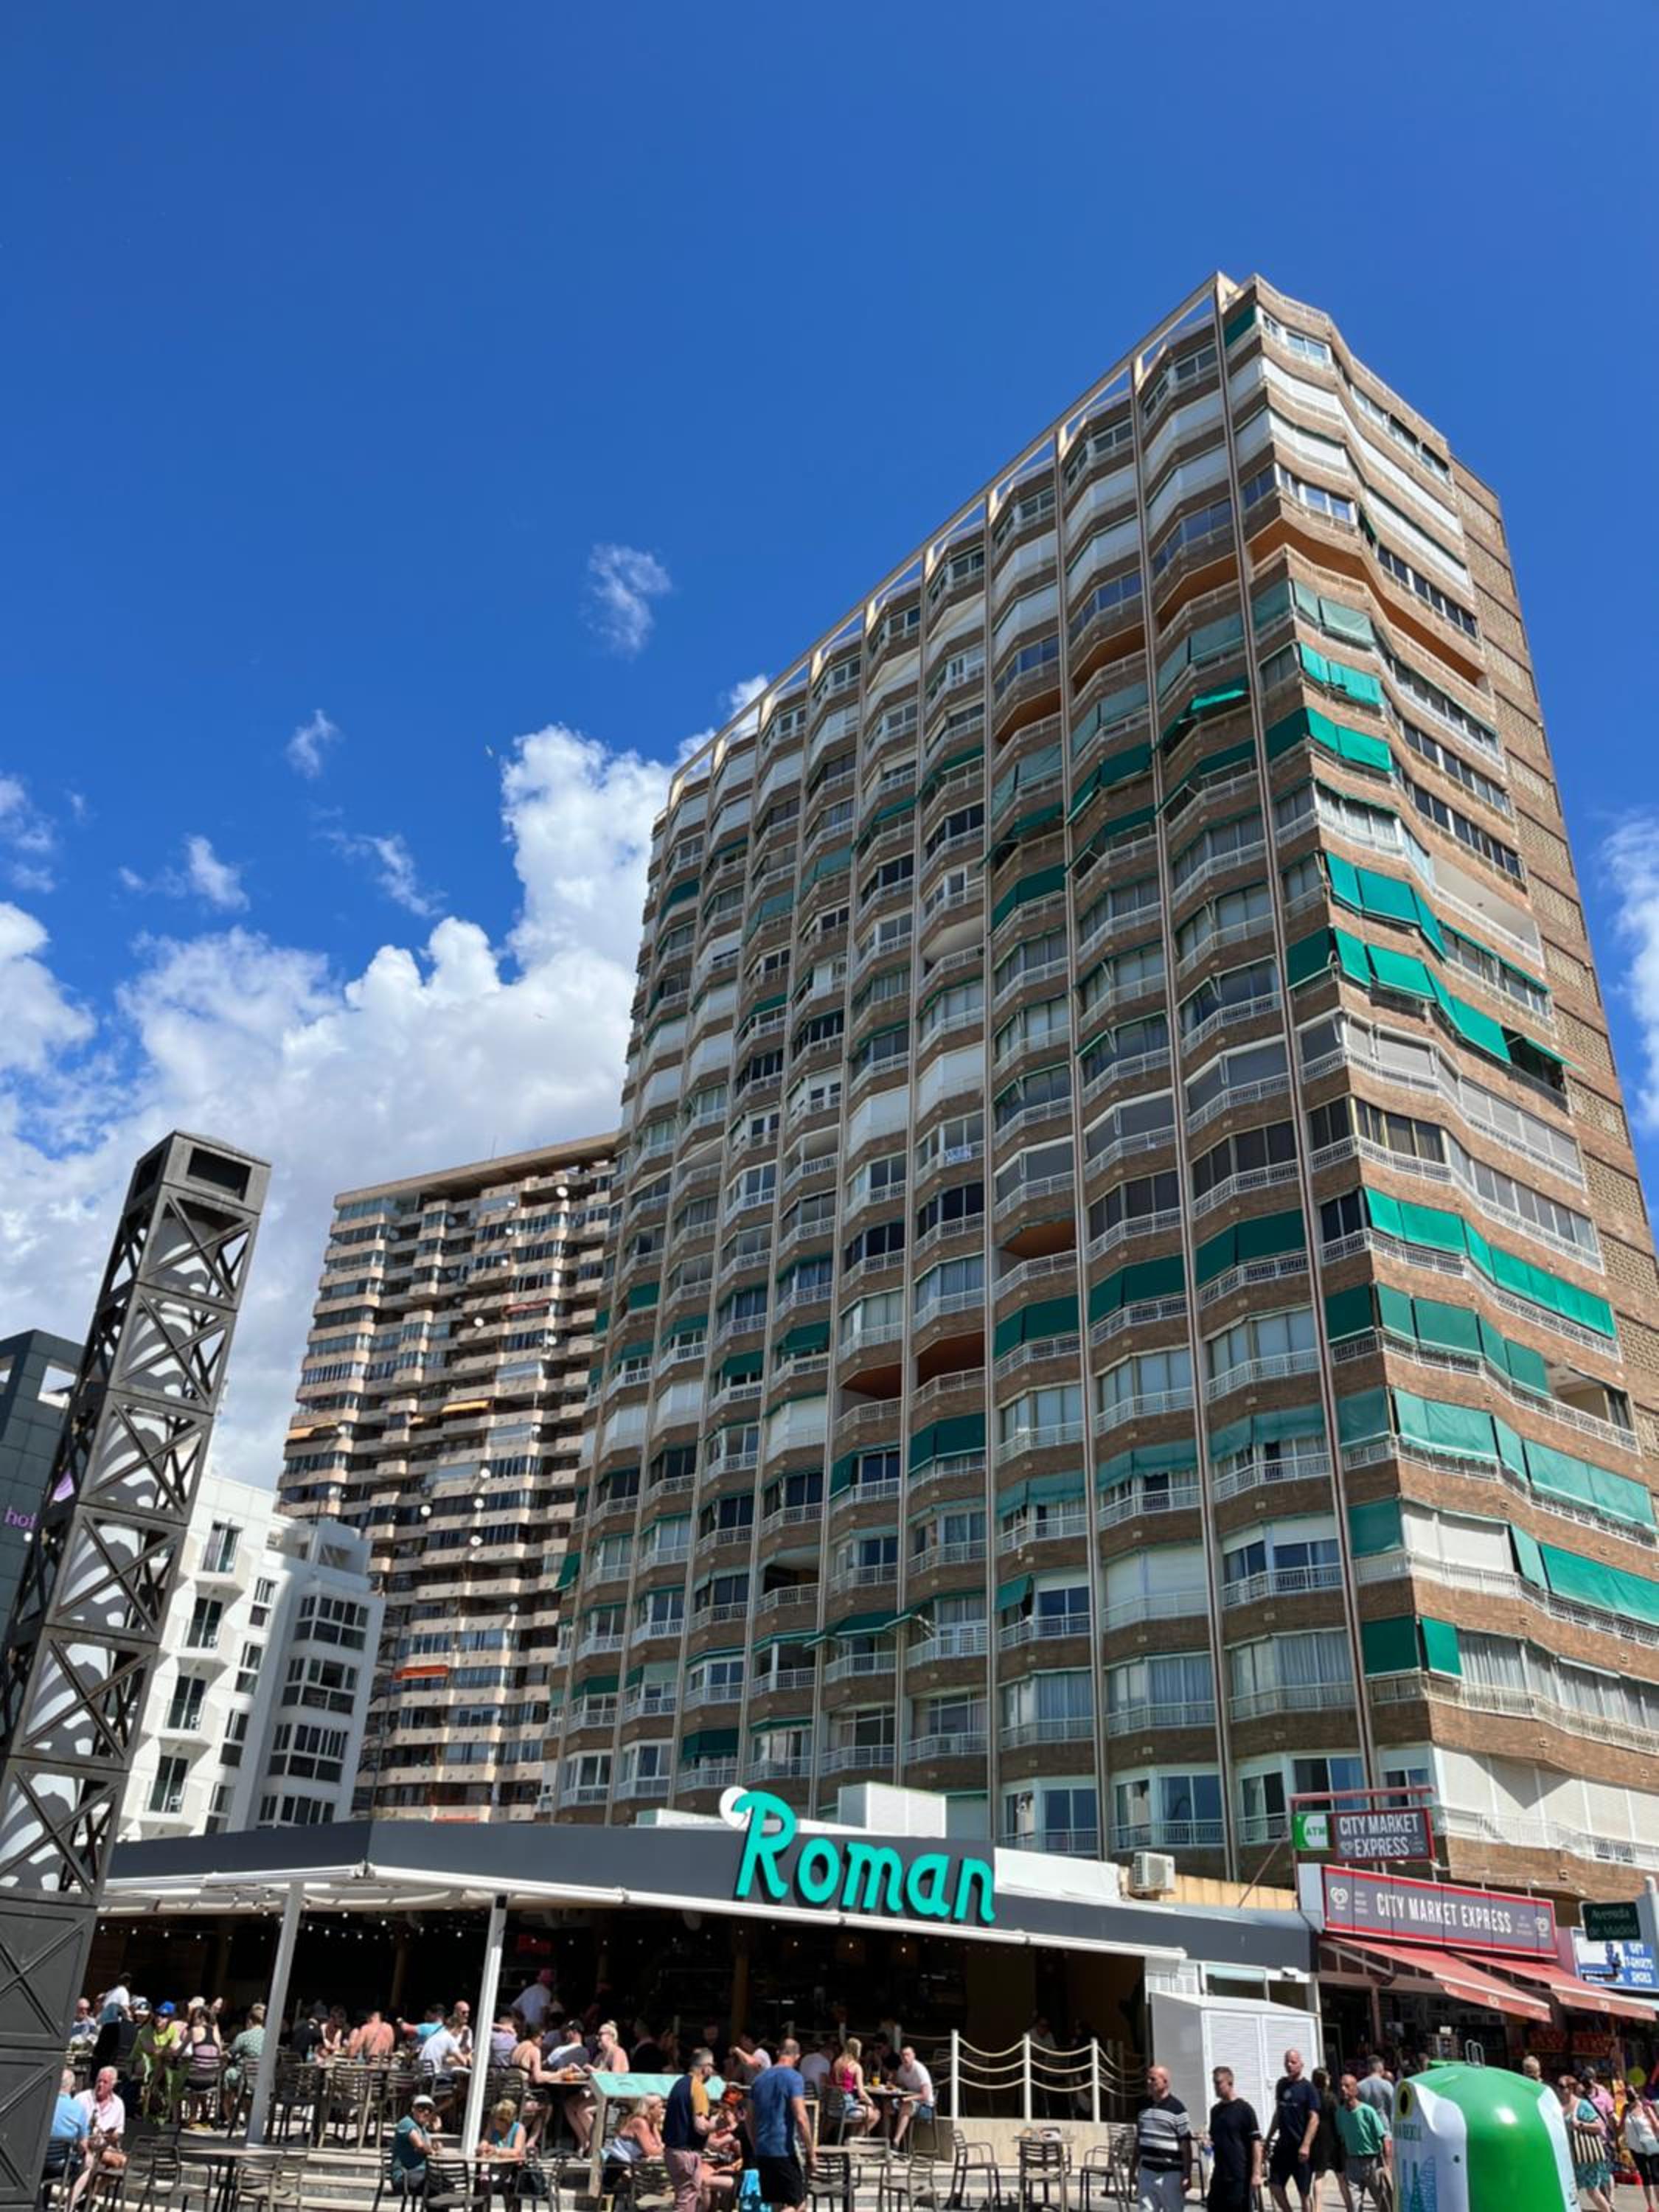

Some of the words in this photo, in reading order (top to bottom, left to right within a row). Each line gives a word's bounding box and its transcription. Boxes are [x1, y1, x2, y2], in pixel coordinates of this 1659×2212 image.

[1306, 1826, 1327, 1837] ATM
[1339, 1815, 1366, 1836] CITY
[1368, 1813, 1419, 1834] MARKET
[731, 1790, 996, 1921] Roman
[1354, 1836, 1410, 1858] EXPRESS
[1376, 1892, 1404, 1919] CITY
[1408, 1897, 1458, 1927] MARKET
[1461, 1904, 1512, 1934] EXPRESS
